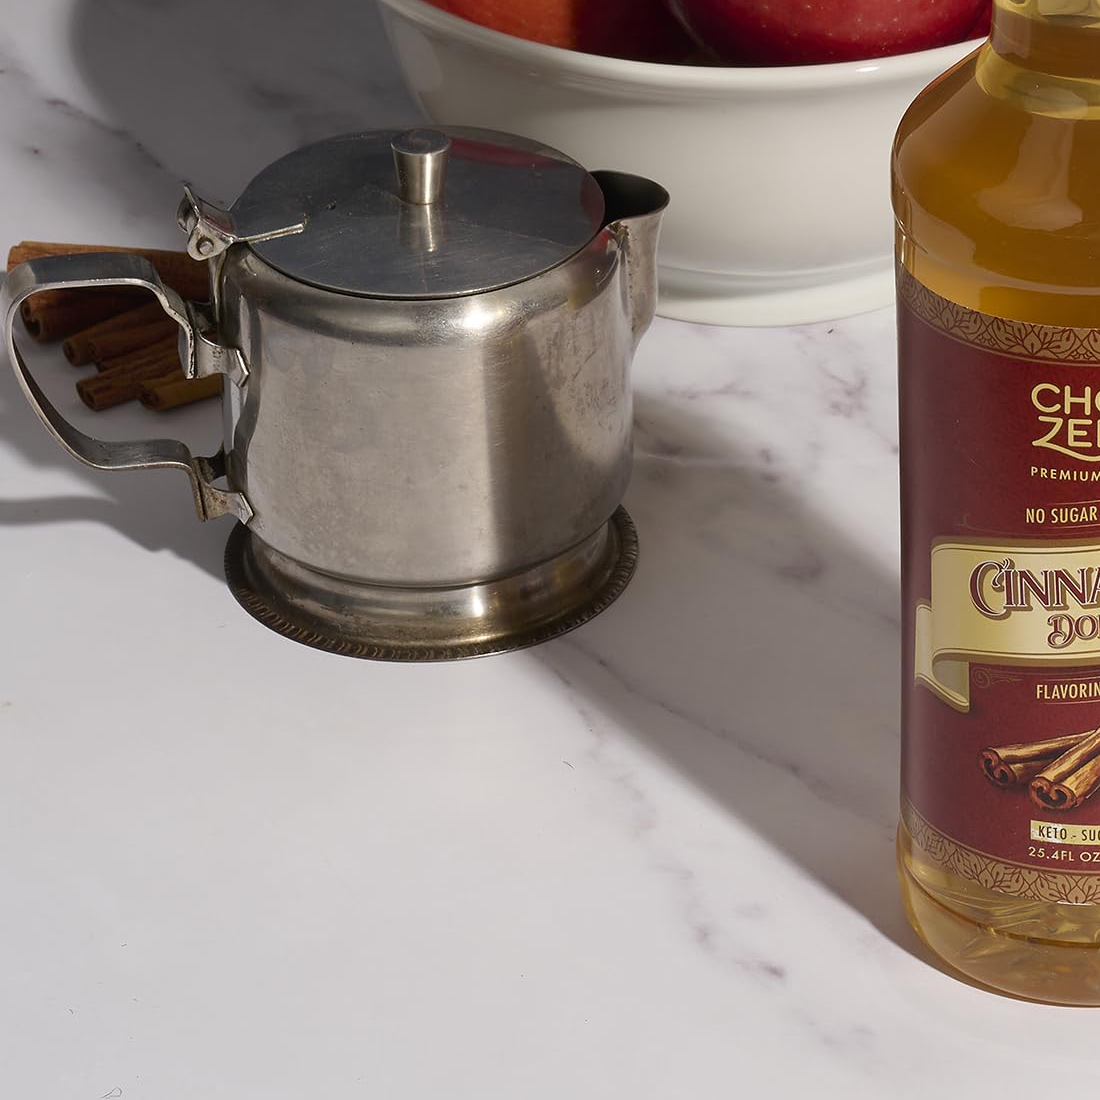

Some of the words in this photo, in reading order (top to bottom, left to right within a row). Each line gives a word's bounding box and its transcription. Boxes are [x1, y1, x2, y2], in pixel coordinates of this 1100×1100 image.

[1026, 508, 1045, 524] NO
[1051, 505, 1098, 523] SUGAR
[1038, 825, 1067, 840] KETO
[1028, 846, 1075, 862] 25.4FL
[1079, 851, 1100, 863] OZ
